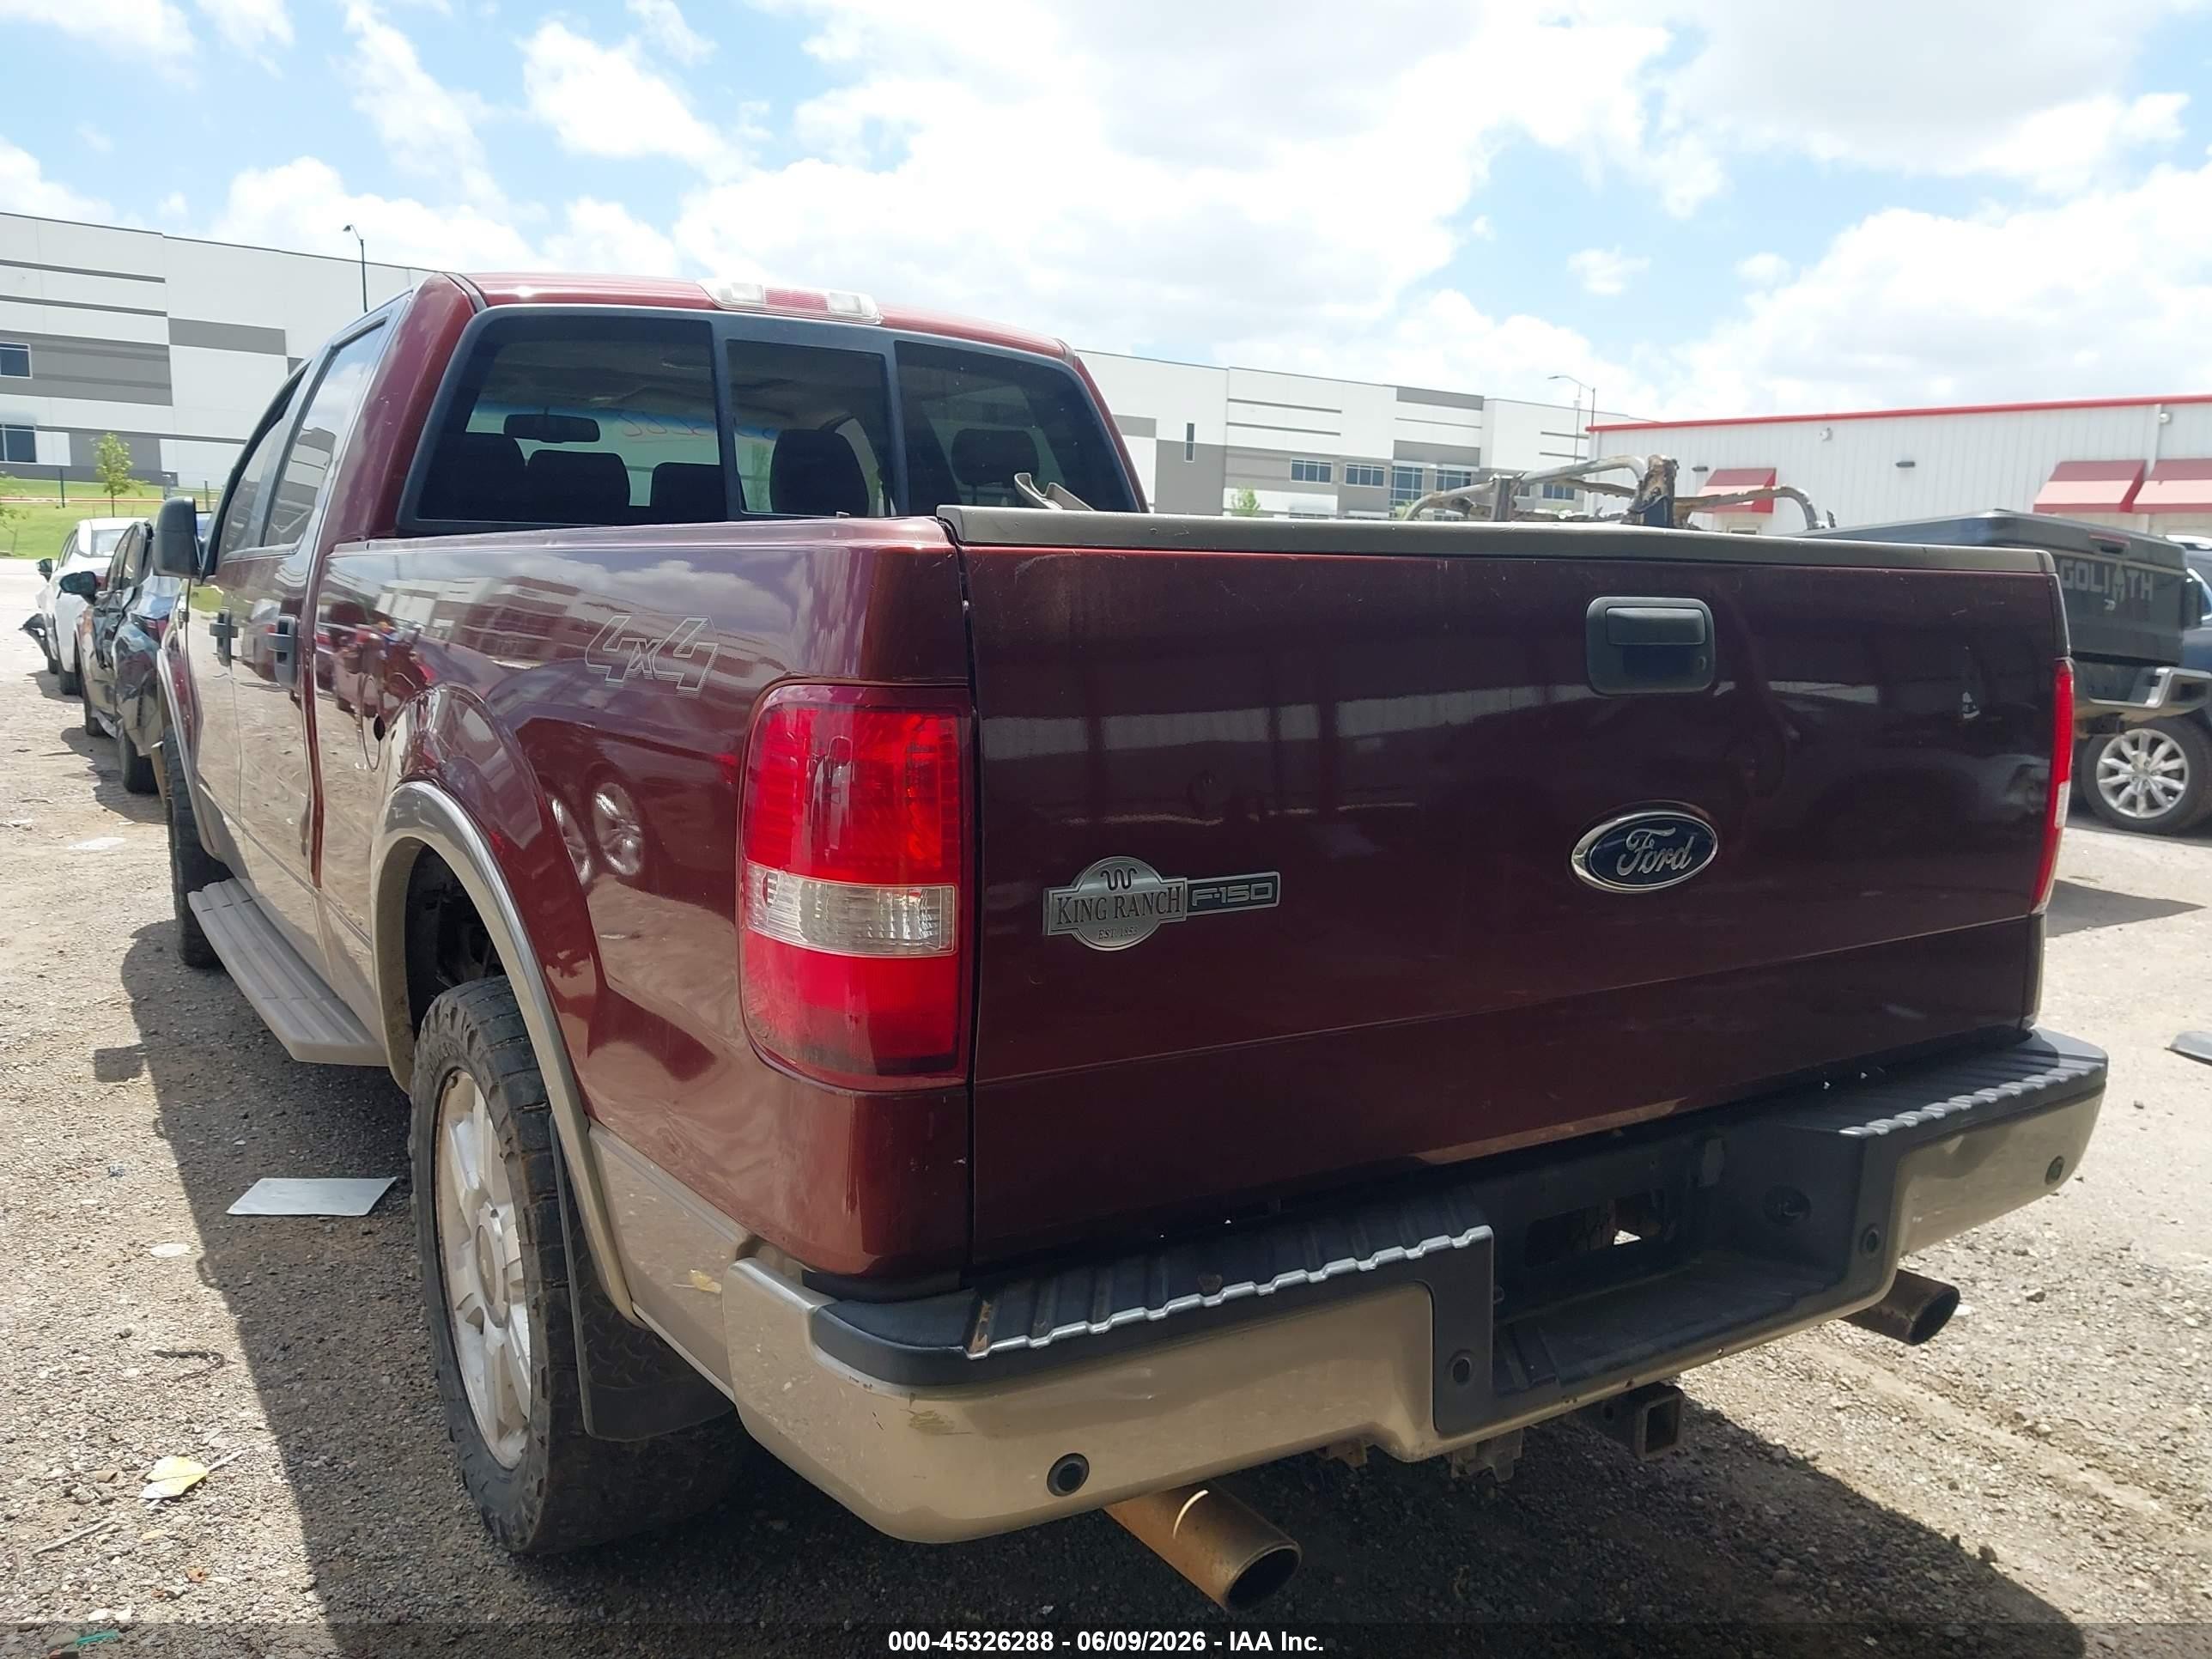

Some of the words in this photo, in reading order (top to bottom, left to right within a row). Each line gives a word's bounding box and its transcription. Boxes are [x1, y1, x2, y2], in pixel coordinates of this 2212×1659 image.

[1616, 827, 1695, 876] Ford
[1056, 896, 1108, 925] KING
[1113, 885, 1182, 920] RANCH
[1191, 882, 1273, 907] F-150
